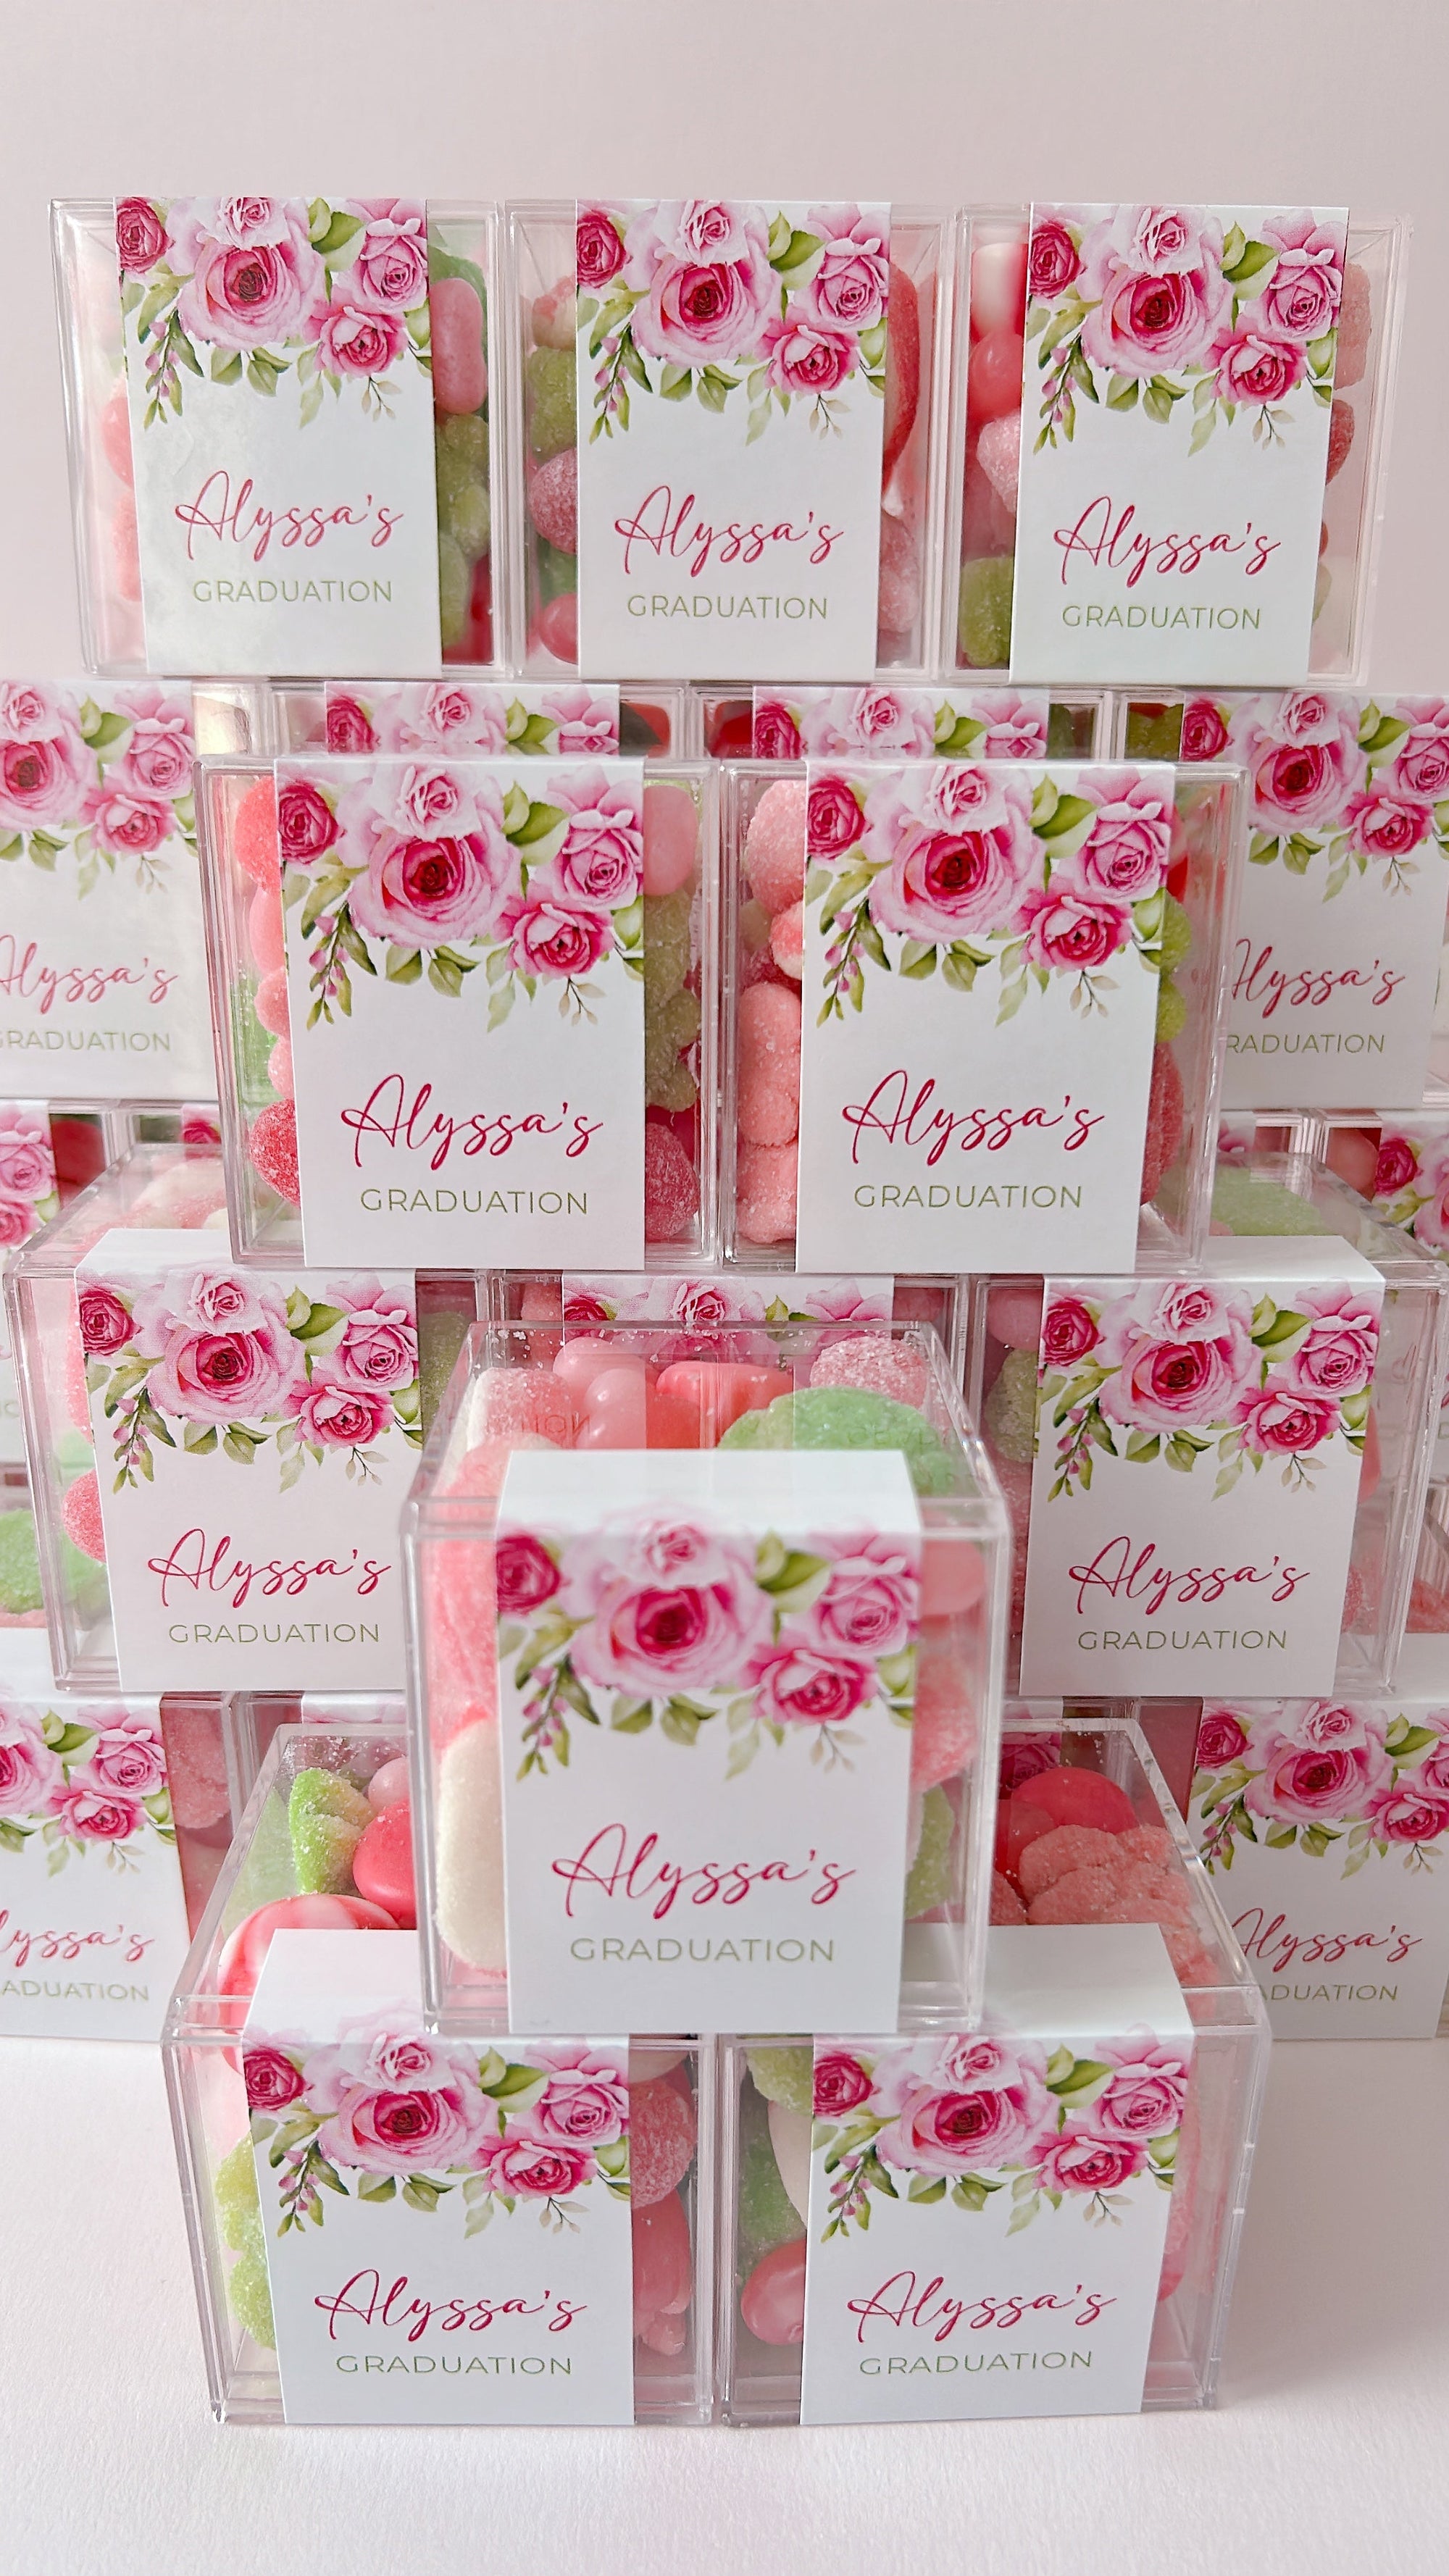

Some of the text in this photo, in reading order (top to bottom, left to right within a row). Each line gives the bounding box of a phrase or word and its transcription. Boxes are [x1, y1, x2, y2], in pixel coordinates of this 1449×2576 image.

[174, 470, 404, 562] Alyssa's
[614, 485, 844, 578] Alyssa's
[1053, 495, 1281, 588] Alyssa's
[193, 580, 392, 602] GRADUATION
[627, 594, 827, 619] GRADUATION
[1062, 604, 1261, 630] GRADUATION
[0, 1030, 172, 1052] RADUATION
[1226, 1033, 1385, 1055] RADUATION
[339, 1073, 604, 1171] Alyssa's
[840, 1069, 1105, 1167] Alyssa's
[360, 1188, 588, 1215] GRADUATION
[853, 1184, 1082, 1209] GRADUATION
[146, 1528, 391, 1609] Alyssa's
[1068, 1536, 1310, 1616] Alyssa's
[169, 1623, 380, 1644] GRADUATION
[1077, 1630, 1286, 1651] GRADUATION
[551, 1823, 856, 1921] Alyssa's
[571, 1938, 834, 1962] GRADUATION
[1, 1979, 150, 2002] ADUATION
[1260, 1984, 1398, 2002] DUATION
[314, 2269, 585, 2343] Alyssa's
[846, 2270, 1116, 2344] Alyssa's
[335, 2357, 572, 2375] GRADUATION
[860, 2352, 1091, 2374] GRADUATION
